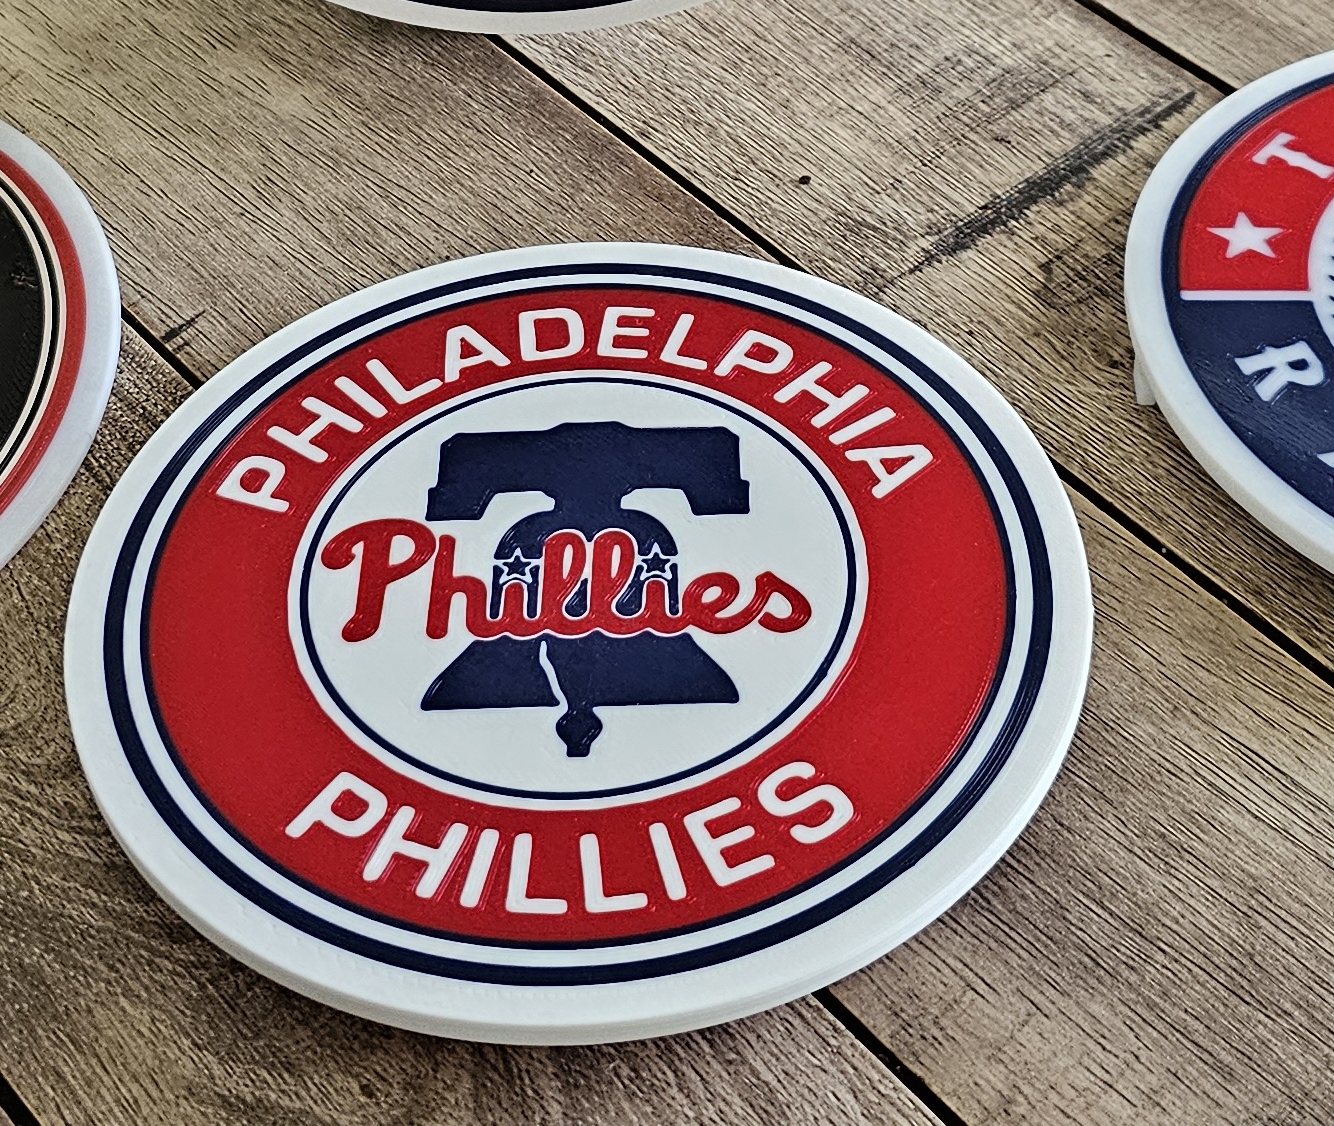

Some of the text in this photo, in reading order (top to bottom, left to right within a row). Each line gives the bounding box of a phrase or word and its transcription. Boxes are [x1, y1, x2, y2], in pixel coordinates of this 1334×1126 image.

[217, 306, 933, 513] PHILADELPHIA
[320, 518, 813, 641] Phillies
[286, 762, 856, 915] PHILLIES
